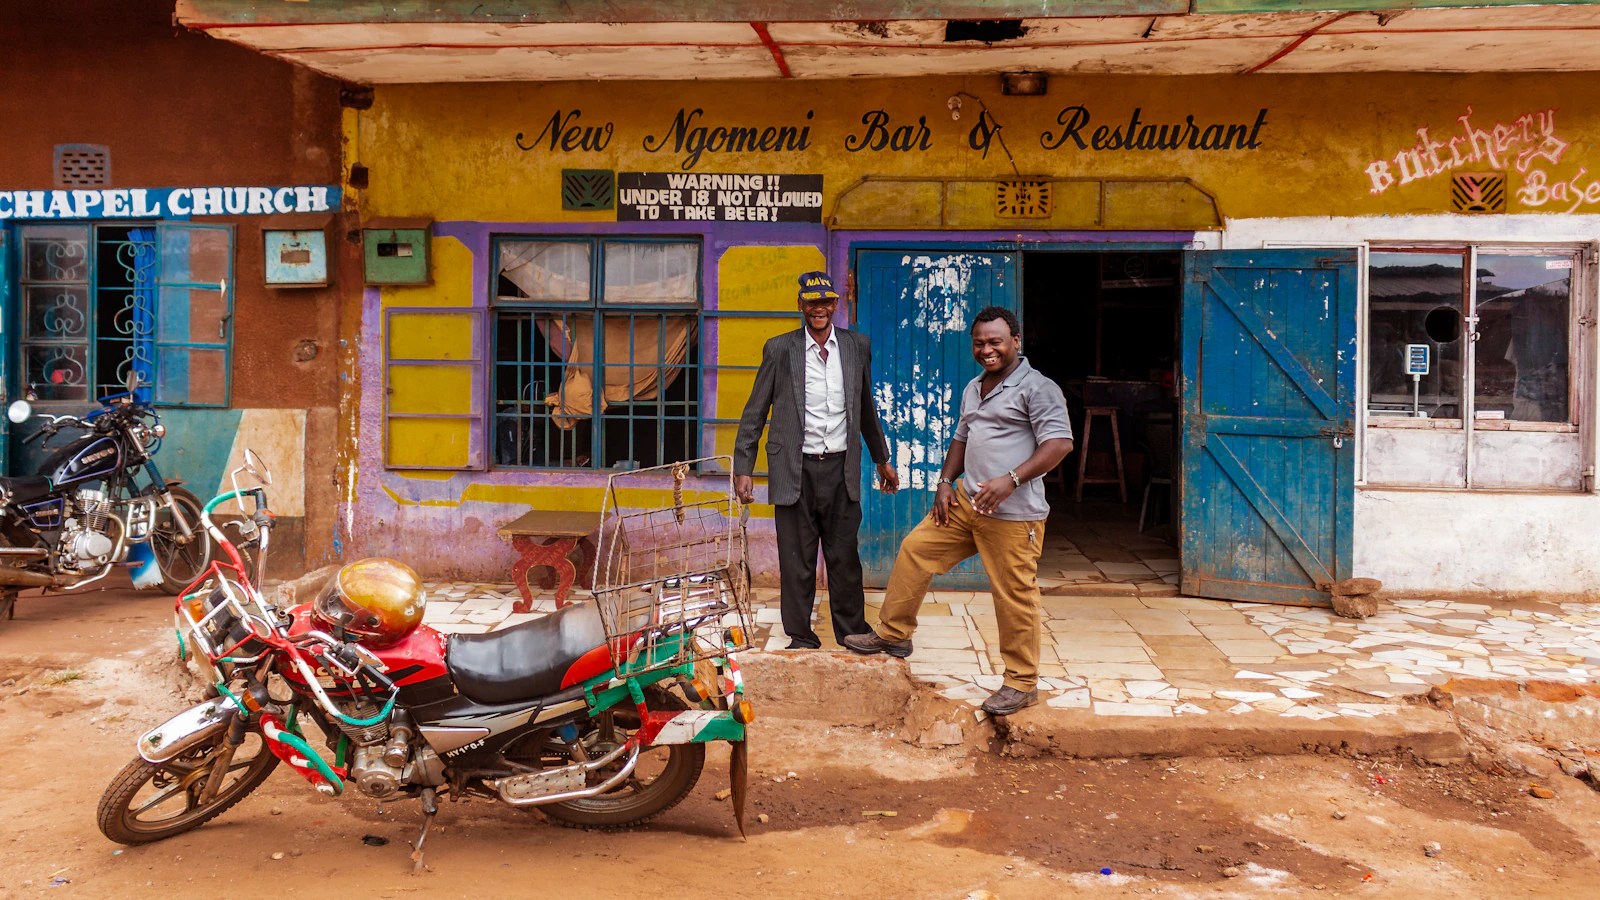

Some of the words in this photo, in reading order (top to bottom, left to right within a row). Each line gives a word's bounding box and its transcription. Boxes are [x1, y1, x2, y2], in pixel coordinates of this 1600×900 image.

[516, 109, 613, 151] New
[644, 108, 814, 170] Ngomeni
[845, 109, 933, 152] Bar
[968, 111, 1002, 160] &
[1040, 103, 1268, 151] Restaurant
[1364, 104, 1571, 196] Butchery
[668, 174, 781, 191] WARNING!!
[0, 188, 161, 219] CHAPEL
[167, 186, 330, 215] CHURCH
[620, 189, 682, 206] UNDER
[691, 190, 709, 206] 18
[717, 191, 752, 206] NOT
[756, 191, 823, 208] ALLOWED
[636, 205, 660, 220] TO
[664, 205, 716, 220] TAKE
[725, 206, 778, 222] BEER!
[806, 277, 831, 287] NAVY
